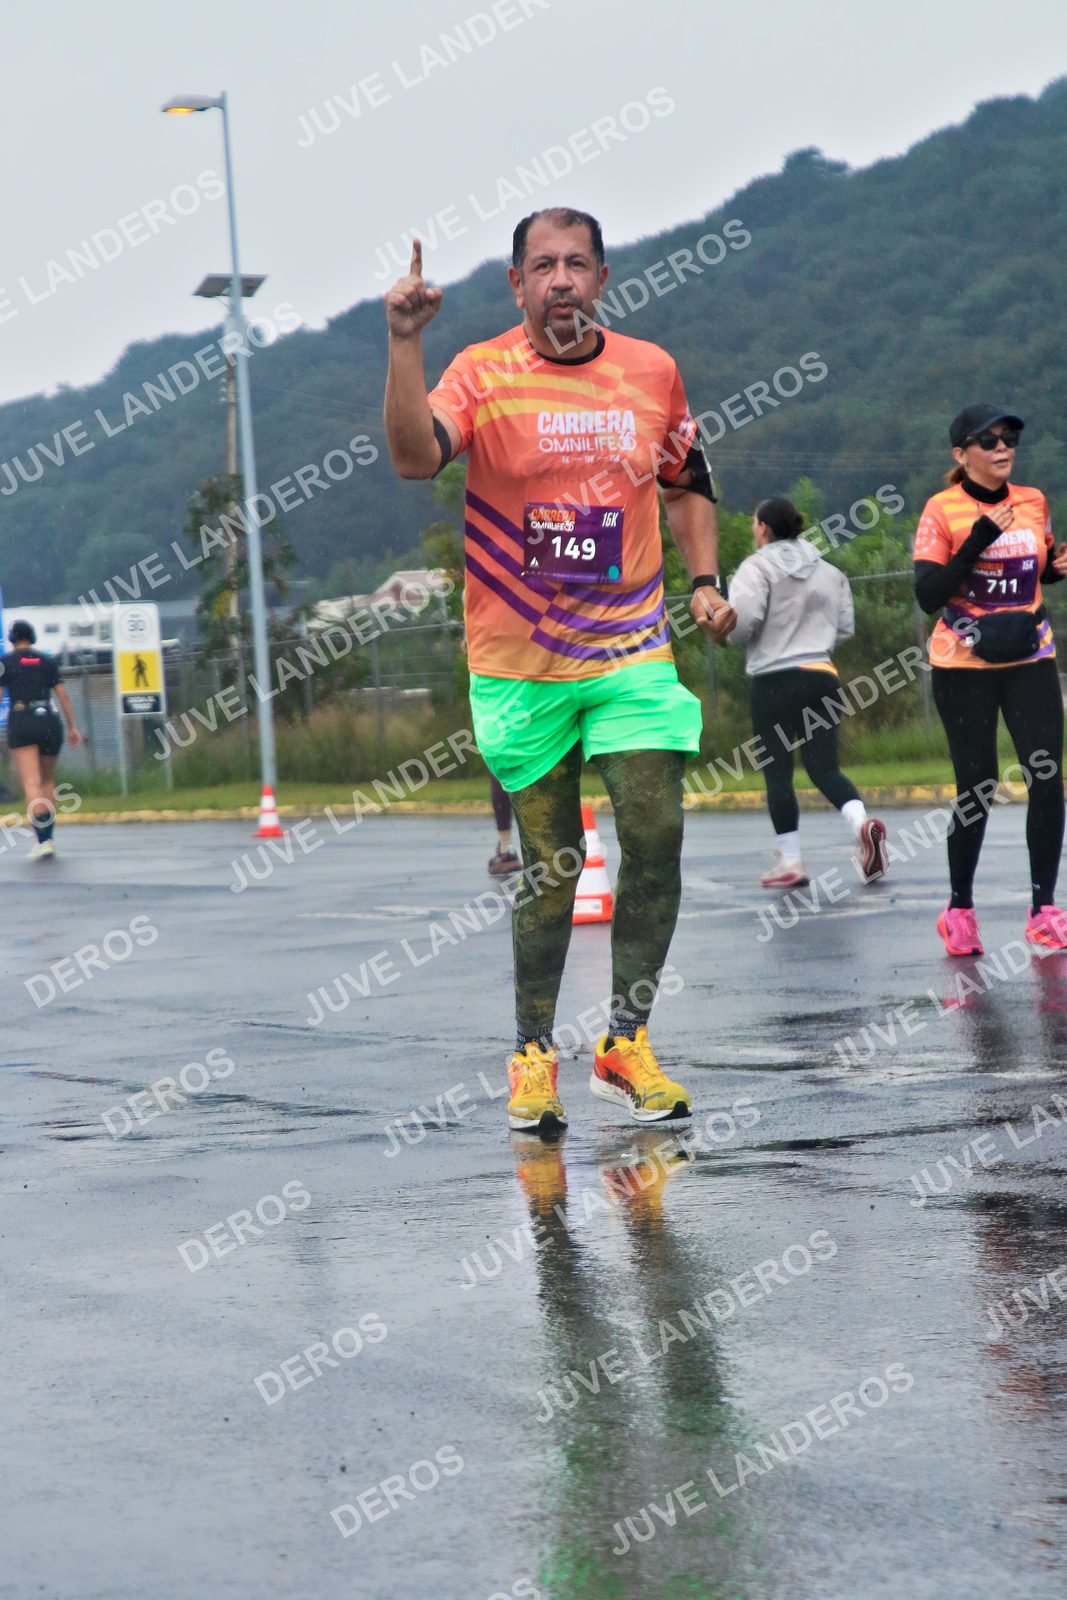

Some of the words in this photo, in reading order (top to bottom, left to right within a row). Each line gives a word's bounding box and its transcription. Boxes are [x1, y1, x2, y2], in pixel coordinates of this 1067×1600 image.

[537, 410, 635, 434] CARRERA
[539, 436, 618, 452] OMNILIFE
[531, 508, 576, 522] CARRERA
[602, 512, 619, 527] 15K
[530, 521, 564, 531] OMNILIFE
[990, 527, 1037, 548] RRERA
[552, 536, 596, 560] 149
[987, 578, 1018, 594] 711
[127, 620, 146, 632] 30
